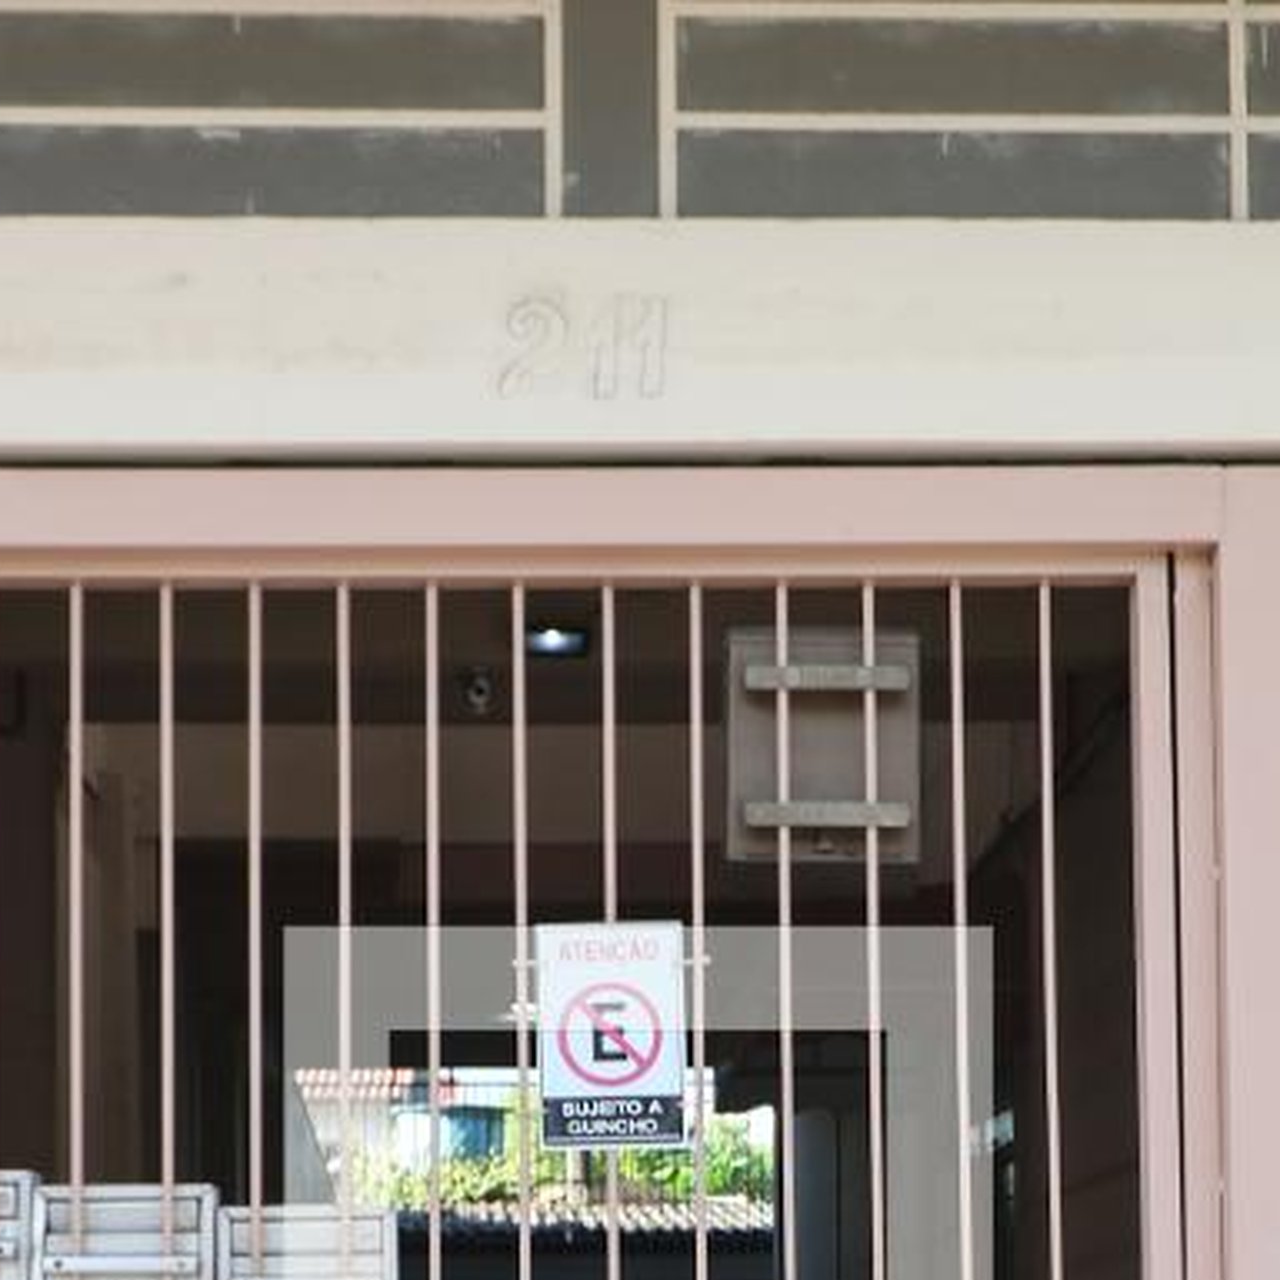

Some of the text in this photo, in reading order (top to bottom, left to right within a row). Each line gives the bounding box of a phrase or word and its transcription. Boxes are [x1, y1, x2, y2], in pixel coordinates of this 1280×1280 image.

[559, 936, 660, 962] ATENÇÃO
[562, 1099, 663, 1118] SUJEITO A
[568, 1118, 659, 1135] GUINCHO
